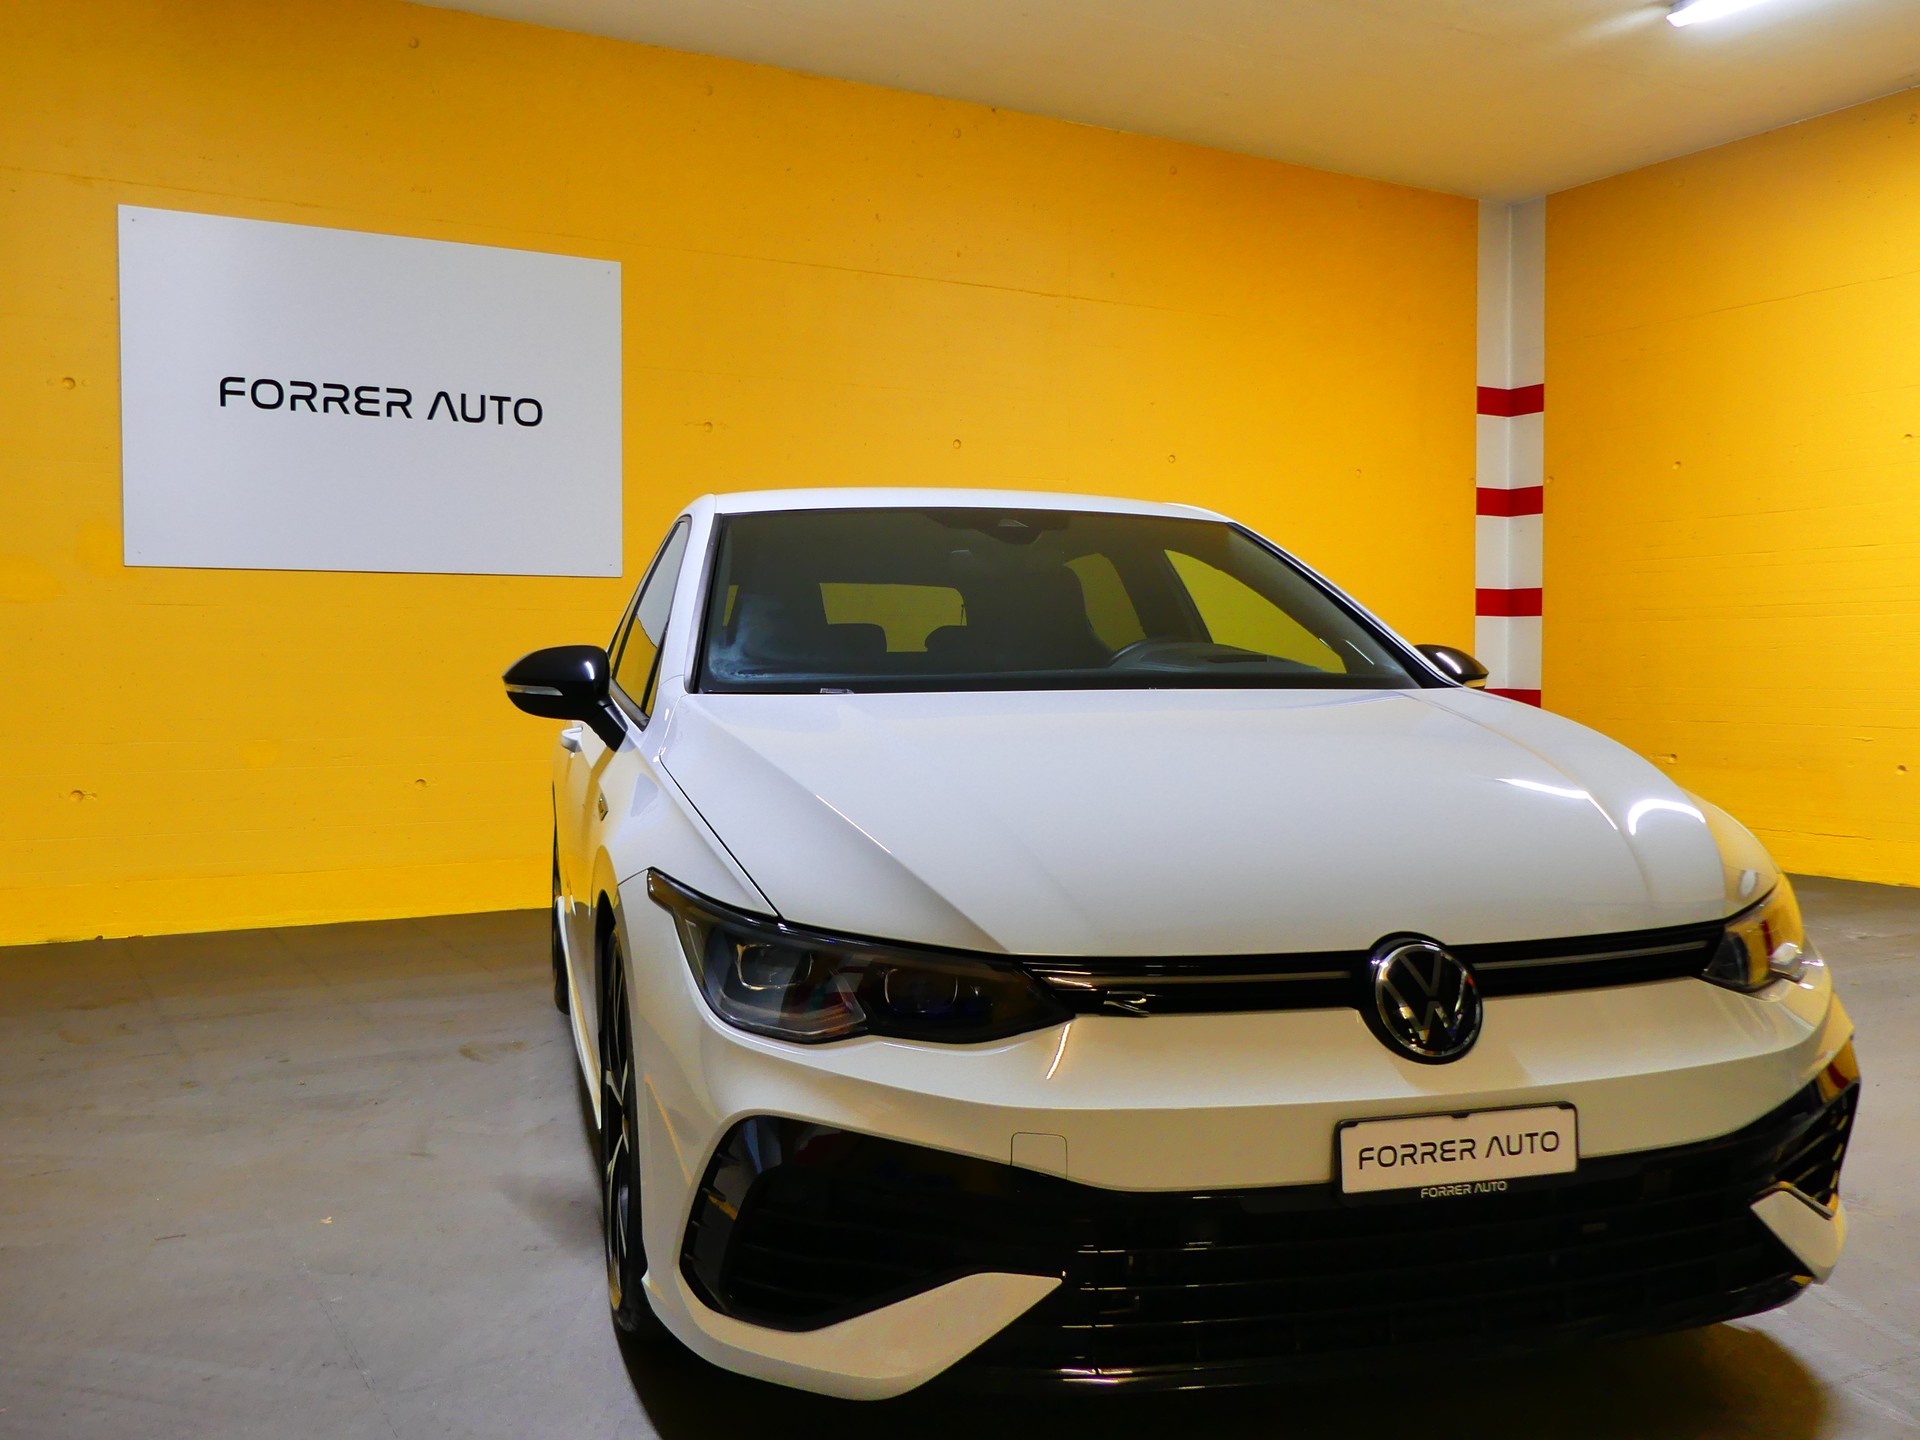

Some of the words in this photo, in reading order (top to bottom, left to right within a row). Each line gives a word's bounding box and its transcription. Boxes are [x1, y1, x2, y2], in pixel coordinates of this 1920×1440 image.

[219, 376, 413, 419] FORRER
[426, 390, 543, 427] AUTO
[1358, 1138, 1477, 1170] FORRER
[1485, 1130, 1560, 1159] AUTO
[1421, 1184, 1471, 1198] FORRER
[1474, 1181, 1507, 1194] AUTO
